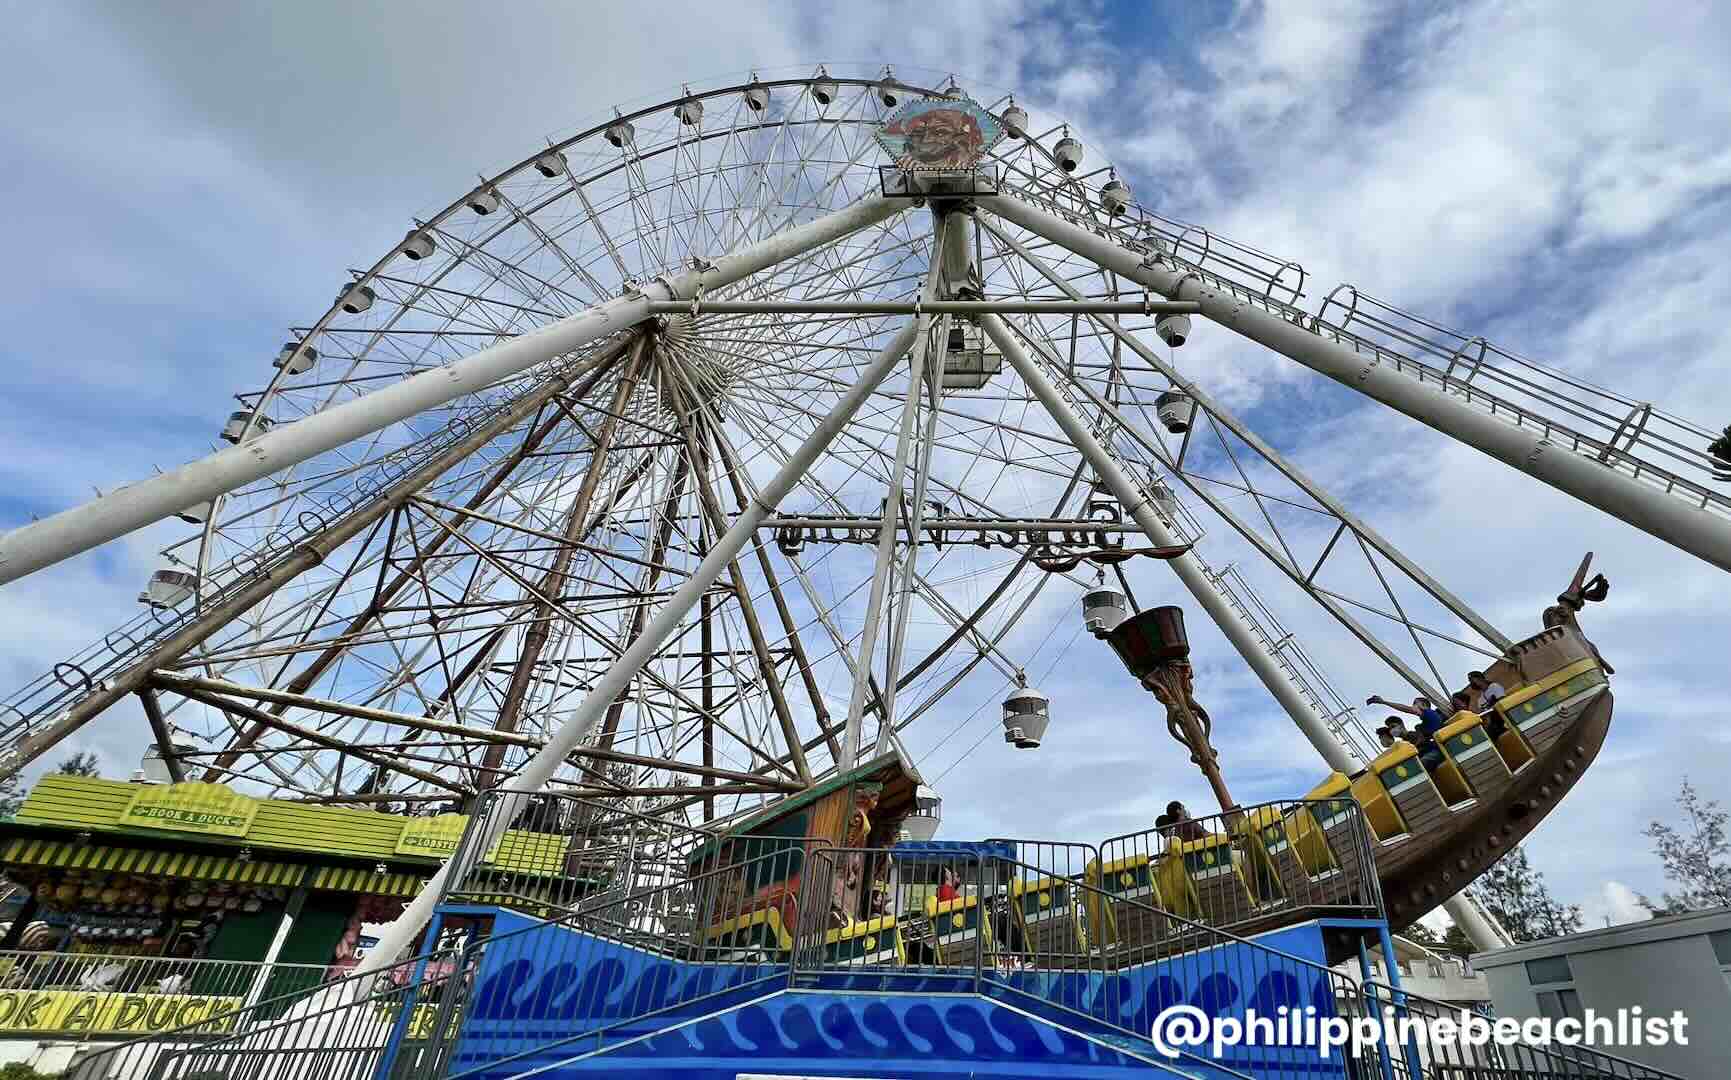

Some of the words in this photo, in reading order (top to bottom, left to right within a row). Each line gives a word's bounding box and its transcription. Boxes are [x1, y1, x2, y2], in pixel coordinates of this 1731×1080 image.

[148, 807, 182, 819] HOOK
[185, 812, 194, 821] A
[198, 814, 232, 825] DUCK
[64, 995, 98, 1030] A
[115, 995, 234, 1032] DUCK
